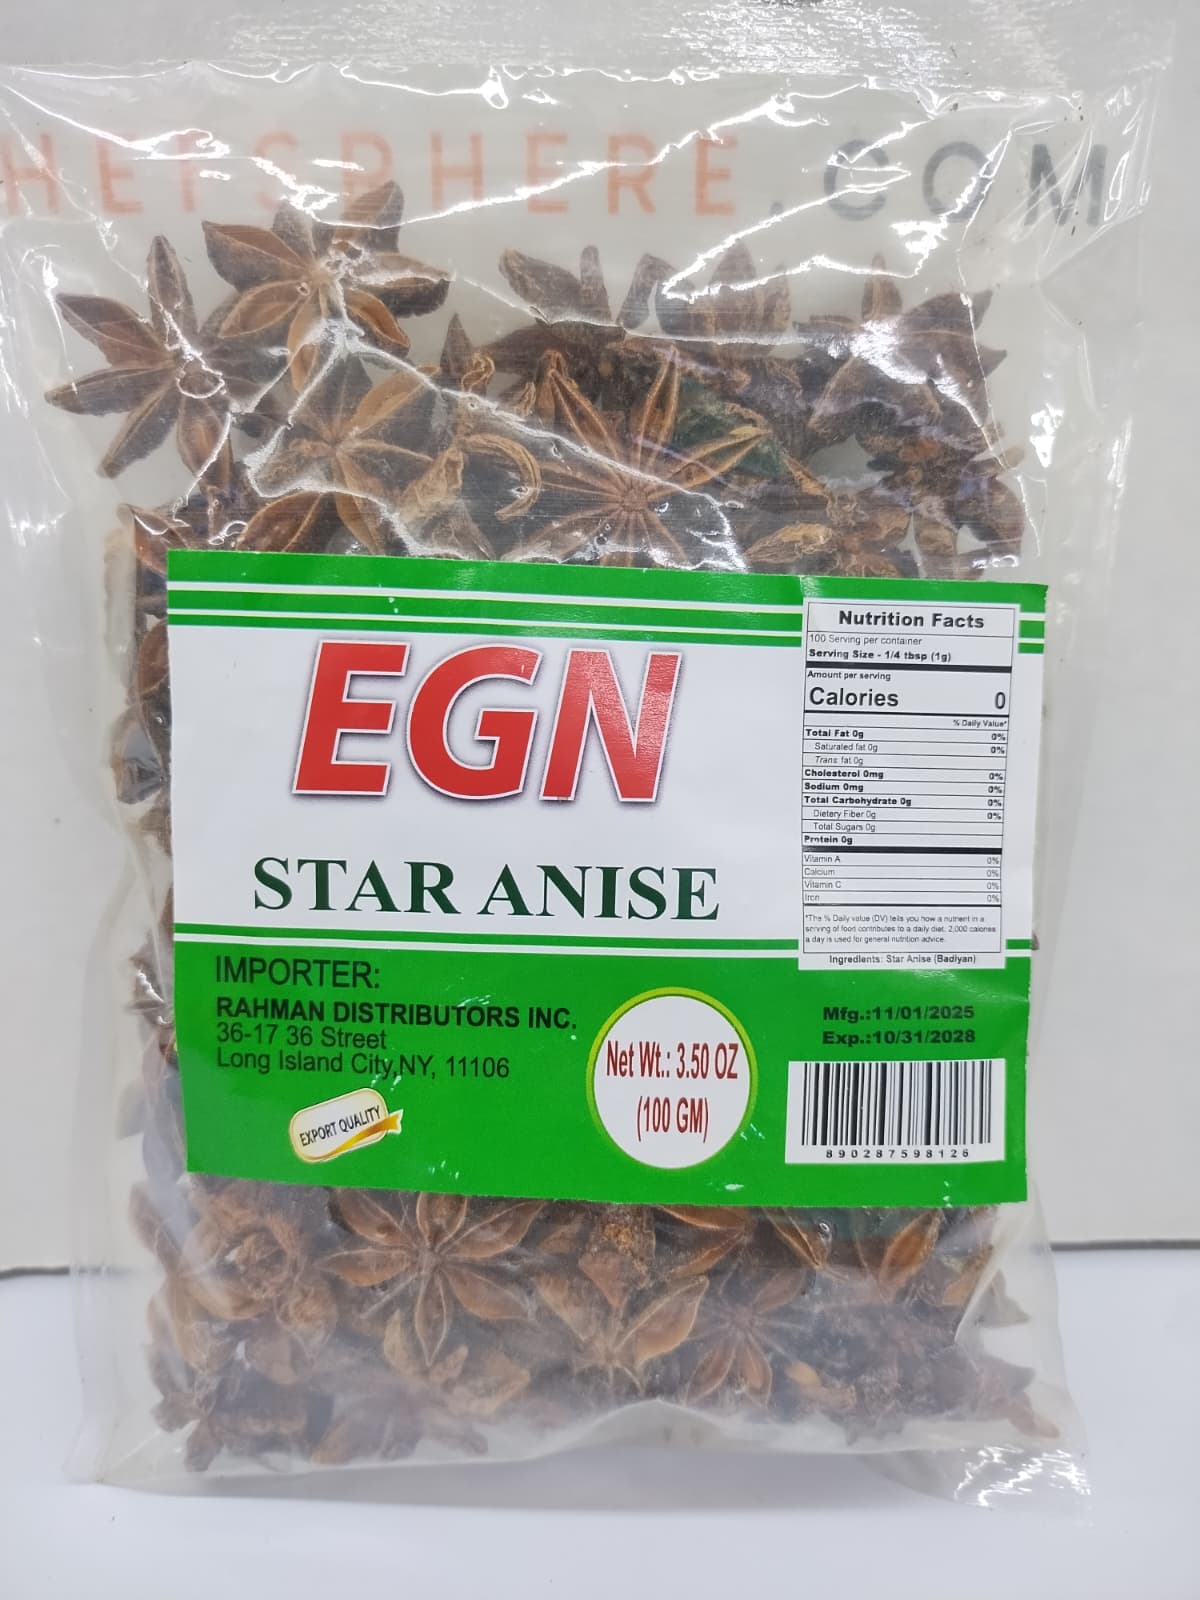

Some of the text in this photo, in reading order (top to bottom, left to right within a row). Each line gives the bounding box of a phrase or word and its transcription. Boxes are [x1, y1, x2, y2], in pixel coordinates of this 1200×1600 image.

[838, 610, 985, 629] Nutrition Facts
[810, 634, 922, 645] 100 Serving per container
[809, 649, 848, 659] Serving
[852, 650, 874, 658] Size
[885, 651, 900, 659] 1/4
[904, 652, 928, 661] tbsp
[931, 652, 951, 662] (1g)
[807, 670, 891, 681] Amount per serving
[809, 687, 1006, 710] Calories 0
[292, 640, 683, 803] EGN
[953, 719, 960, 727] %
[961, 719, 981, 728] Daily
[805, 729, 1006, 741] Total Fat 0g 0%
[814, 742, 1005, 754] Saturated fat 0g 0%
[815, 756, 863, 766] Trans fat 0g
[804, 769, 1003, 780] Cholesterol 0mg 0%
[804, 782, 840, 790] Sodium
[843, 783, 864, 792] 0mg
[804, 796, 1002, 807] Total Carbohydrate 0g 0%
[813, 809, 841, 818] Dietary
[866, 810, 876, 819] 0g
[987, 812, 1001, 820] 0%
[813, 822, 876, 832] Total Sugars 0g
[804, 835, 853, 845] Protein 0g
[804, 855, 999, 865] Vitamin A 0%
[804, 868, 999, 877] Calcium 0%
[253, 855, 720, 921] STAR ANISE
[804, 881, 999, 890] Vitamin C 0%
[986, 894, 999, 902] 0%
[833, 914, 850, 923] Daily
[872, 914, 888, 923] (DV)
[912, 925, 929, 933] daily
[812, 936, 824, 944] day
[864, 936, 889, 944] general
[829, 955, 976, 965] Ingredients: Star Anise (Badiyan)
[215, 955, 381, 989] IMPORTER:
[216, 998, 577, 1030] RAHMAN DISTRIBUTORS INC.
[216, 1022, 386, 1049] 36-17 36 Street
[217, 1047, 270, 1073] Long
[279, 1051, 342, 1073] Island
[447, 1056, 510, 1079] 11106
[607, 1040, 738, 1079] Net Wt.: 3.50 OZ
[637, 1095, 709, 1143] (100 GM)
[299, 1105, 381, 1147] EXPORT QUALITY
